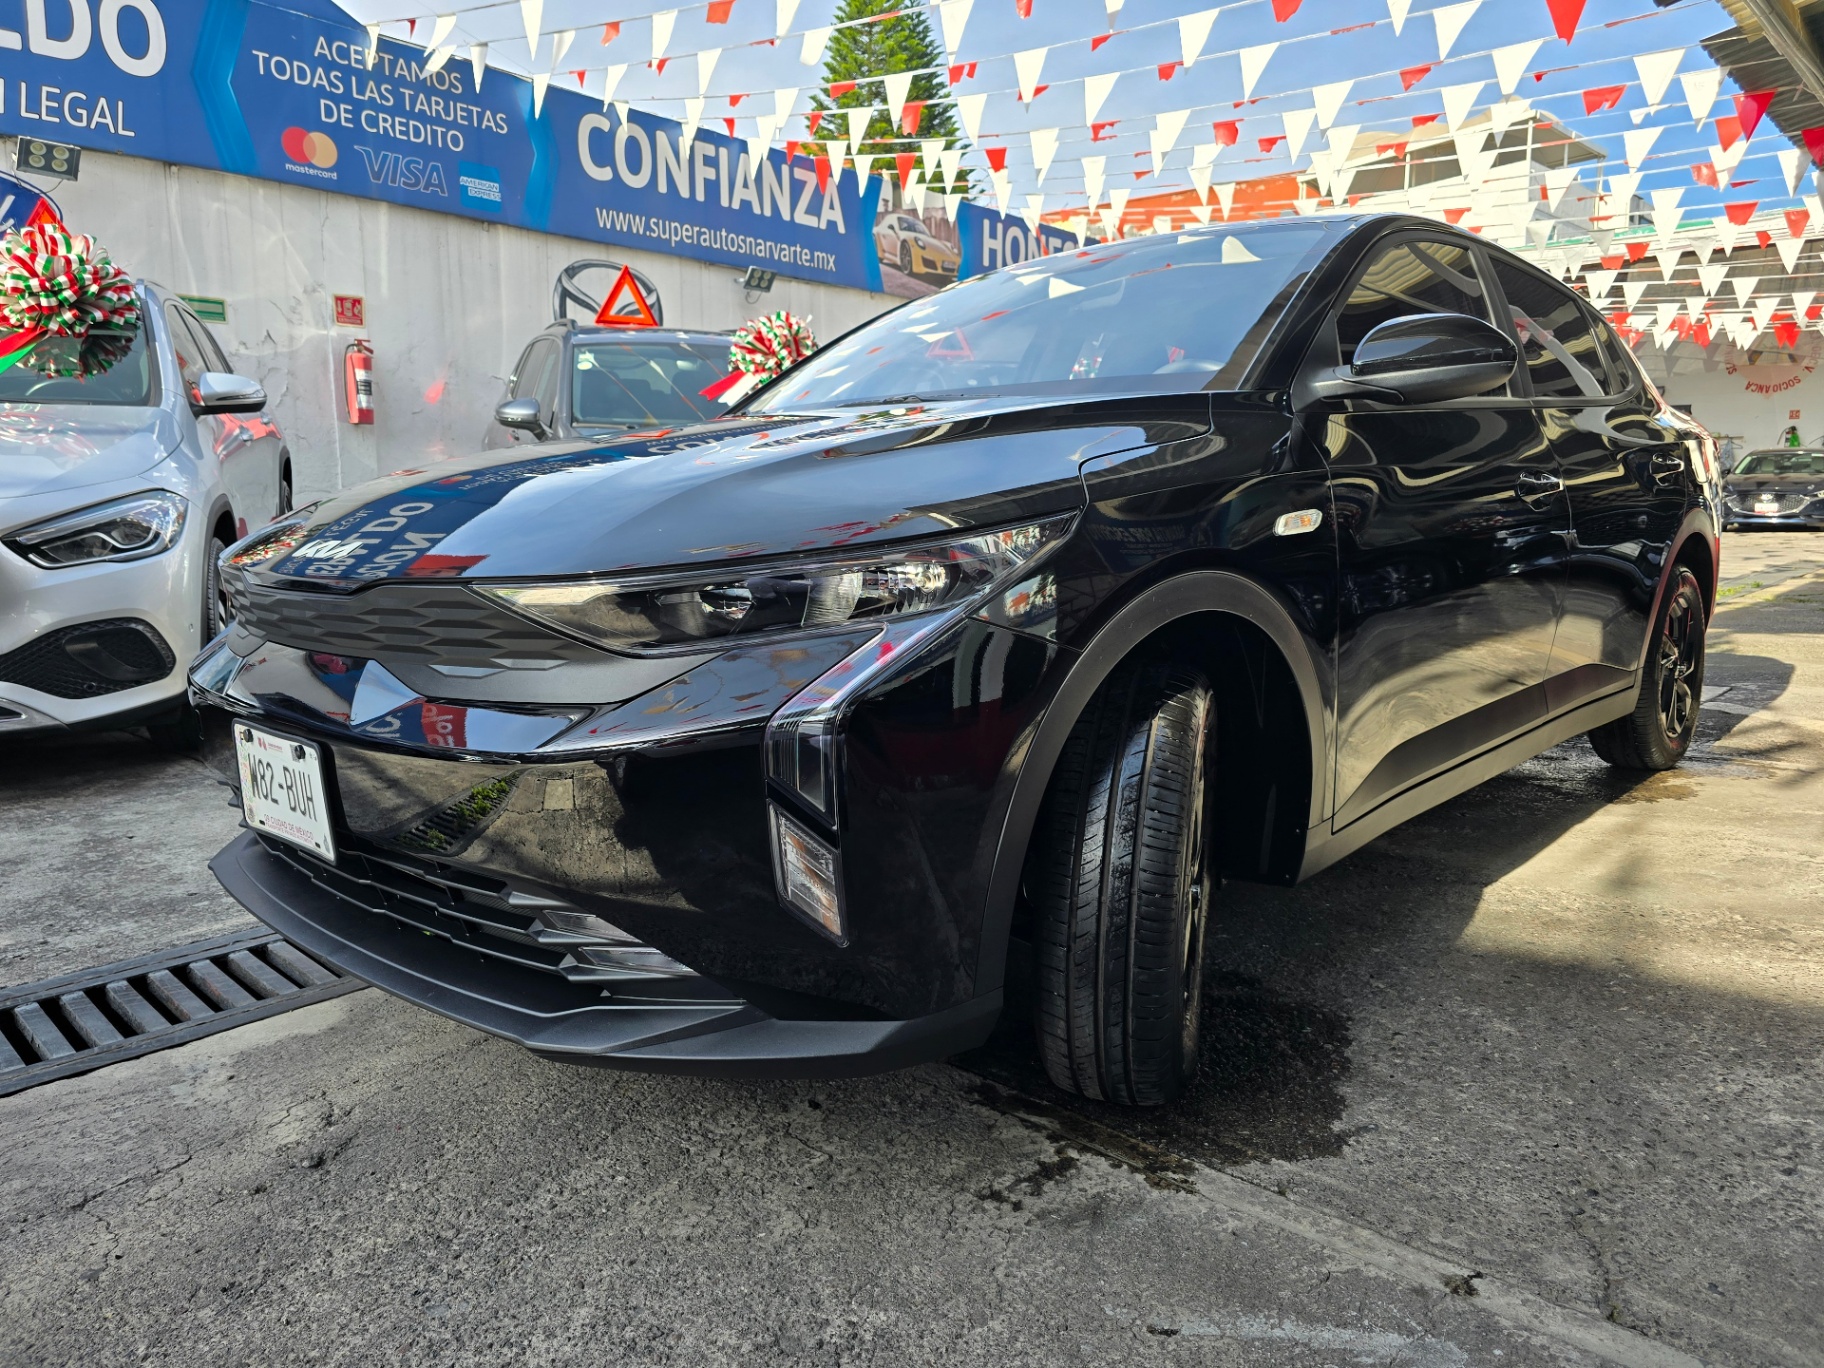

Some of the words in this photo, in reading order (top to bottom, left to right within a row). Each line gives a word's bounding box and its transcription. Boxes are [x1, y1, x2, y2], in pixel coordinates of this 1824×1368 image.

[252, 50, 344, 94] TODAS
[352, 76, 394, 106] LAS
[399, 88, 508, 134] TARJETAS
[314, 36, 463, 94] ACEPTAMOS
[20, 81, 136, 137] LEGAL
[320, 98, 354, 128] DE
[361, 110, 464, 151] CREDITO
[285, 162, 337, 180] mastercard
[353, 145, 448, 197] VISA
[577, 113, 846, 235] CONFIANZA
[596, 207, 836, 272] www.superautosnarvarte.mx
[1745, 381, 1770, 394] ANCA
[1772, 375, 1801, 393] SOCIO
[248, 753, 318, 823] W82-BUH
